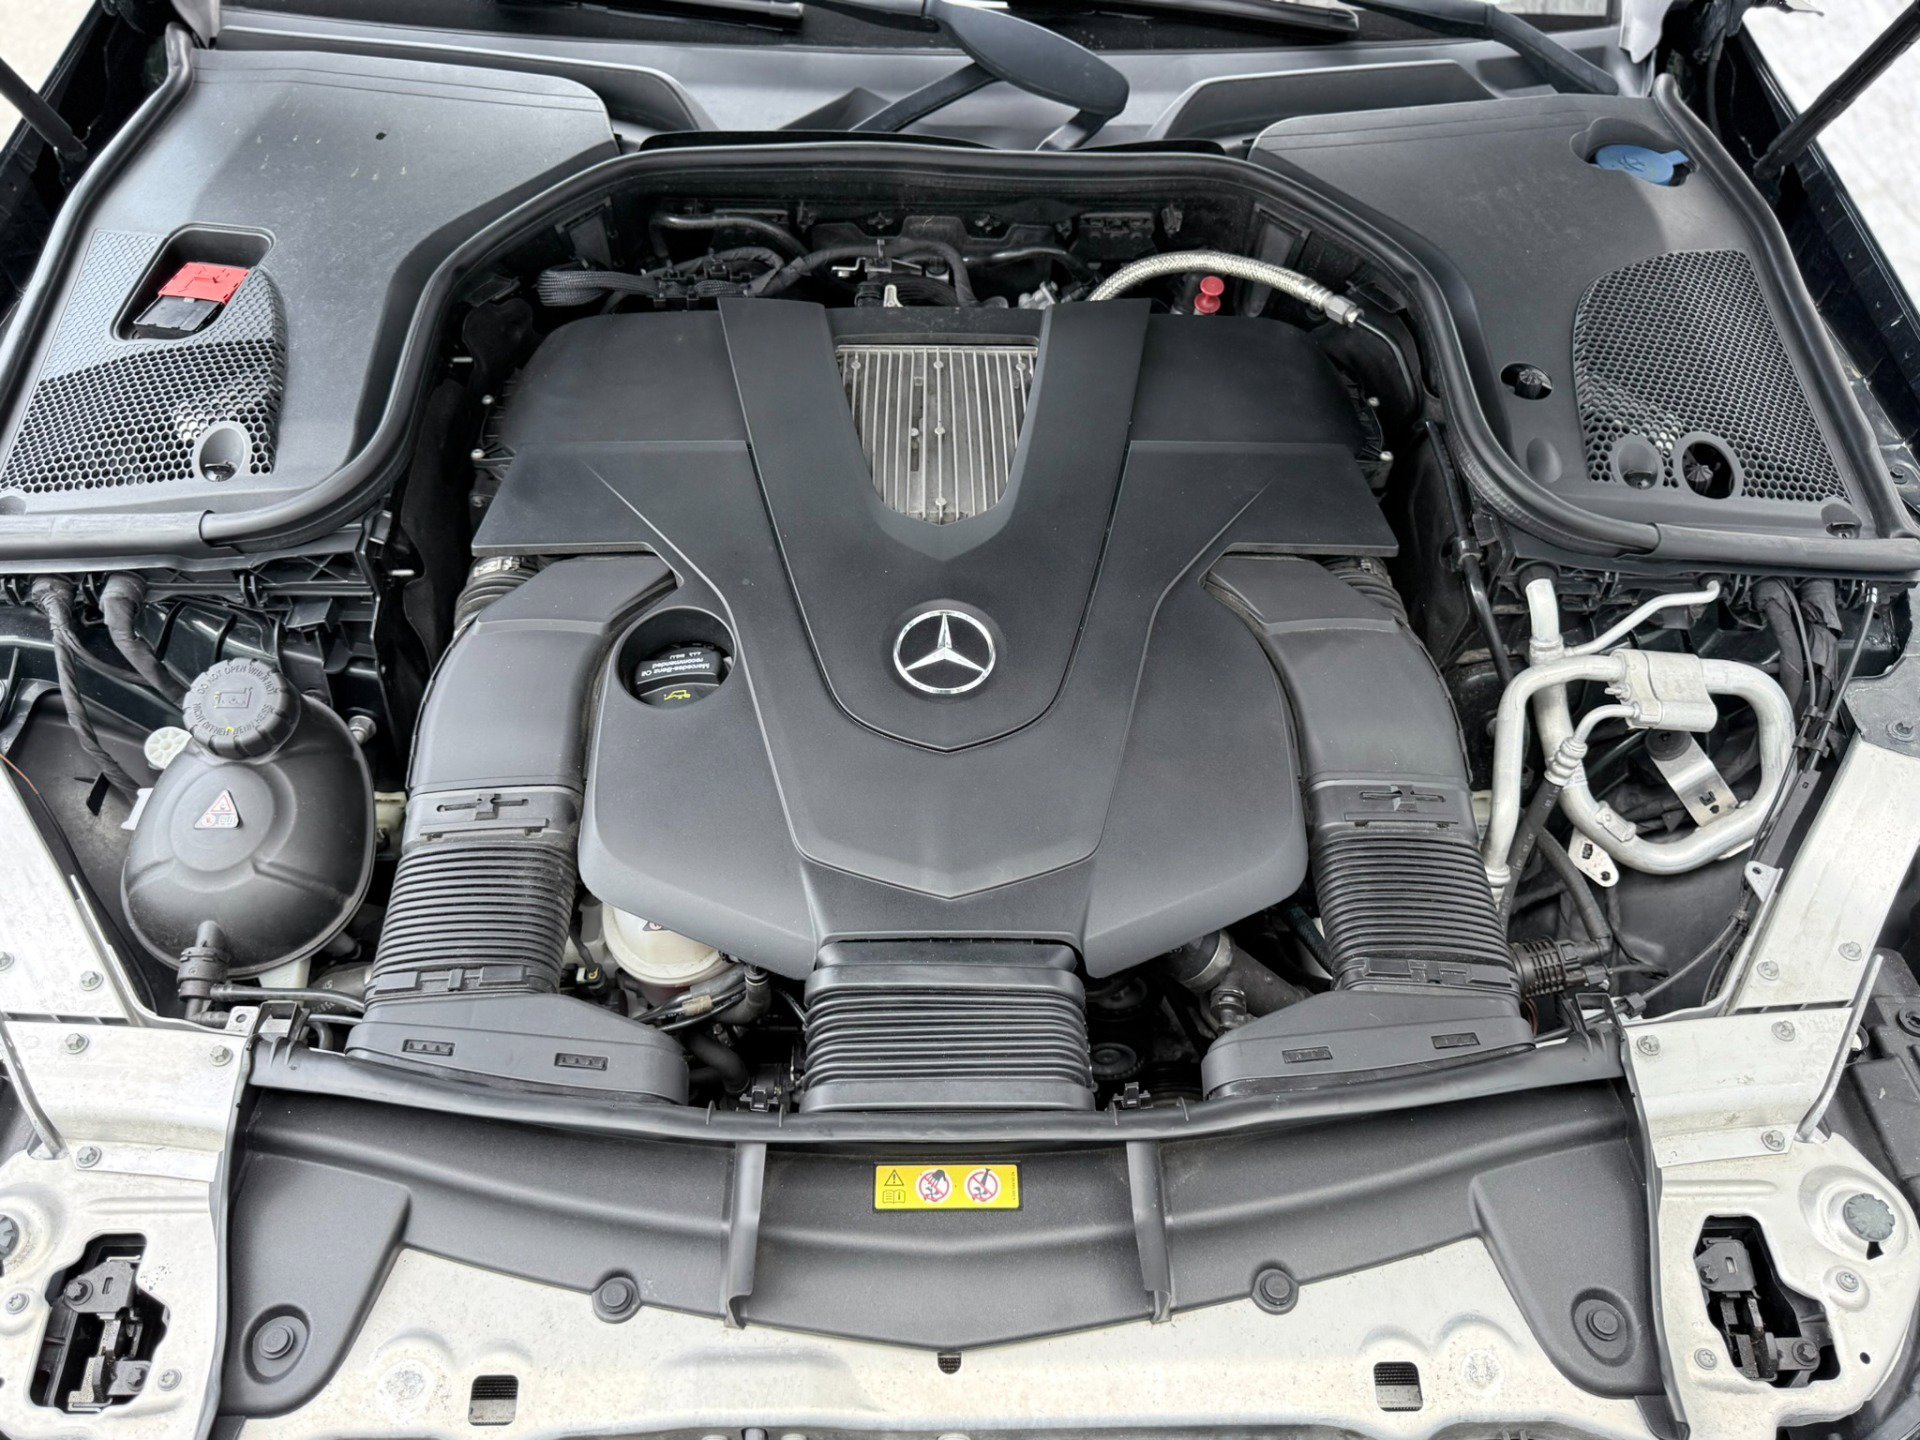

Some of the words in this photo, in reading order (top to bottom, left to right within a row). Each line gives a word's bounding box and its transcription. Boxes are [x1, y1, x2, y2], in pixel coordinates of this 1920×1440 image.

[652, 658, 703, 668] recommended
[654, 663, 709, 673] Mercedes-Benz
[224, 664, 247, 675] OPEN
